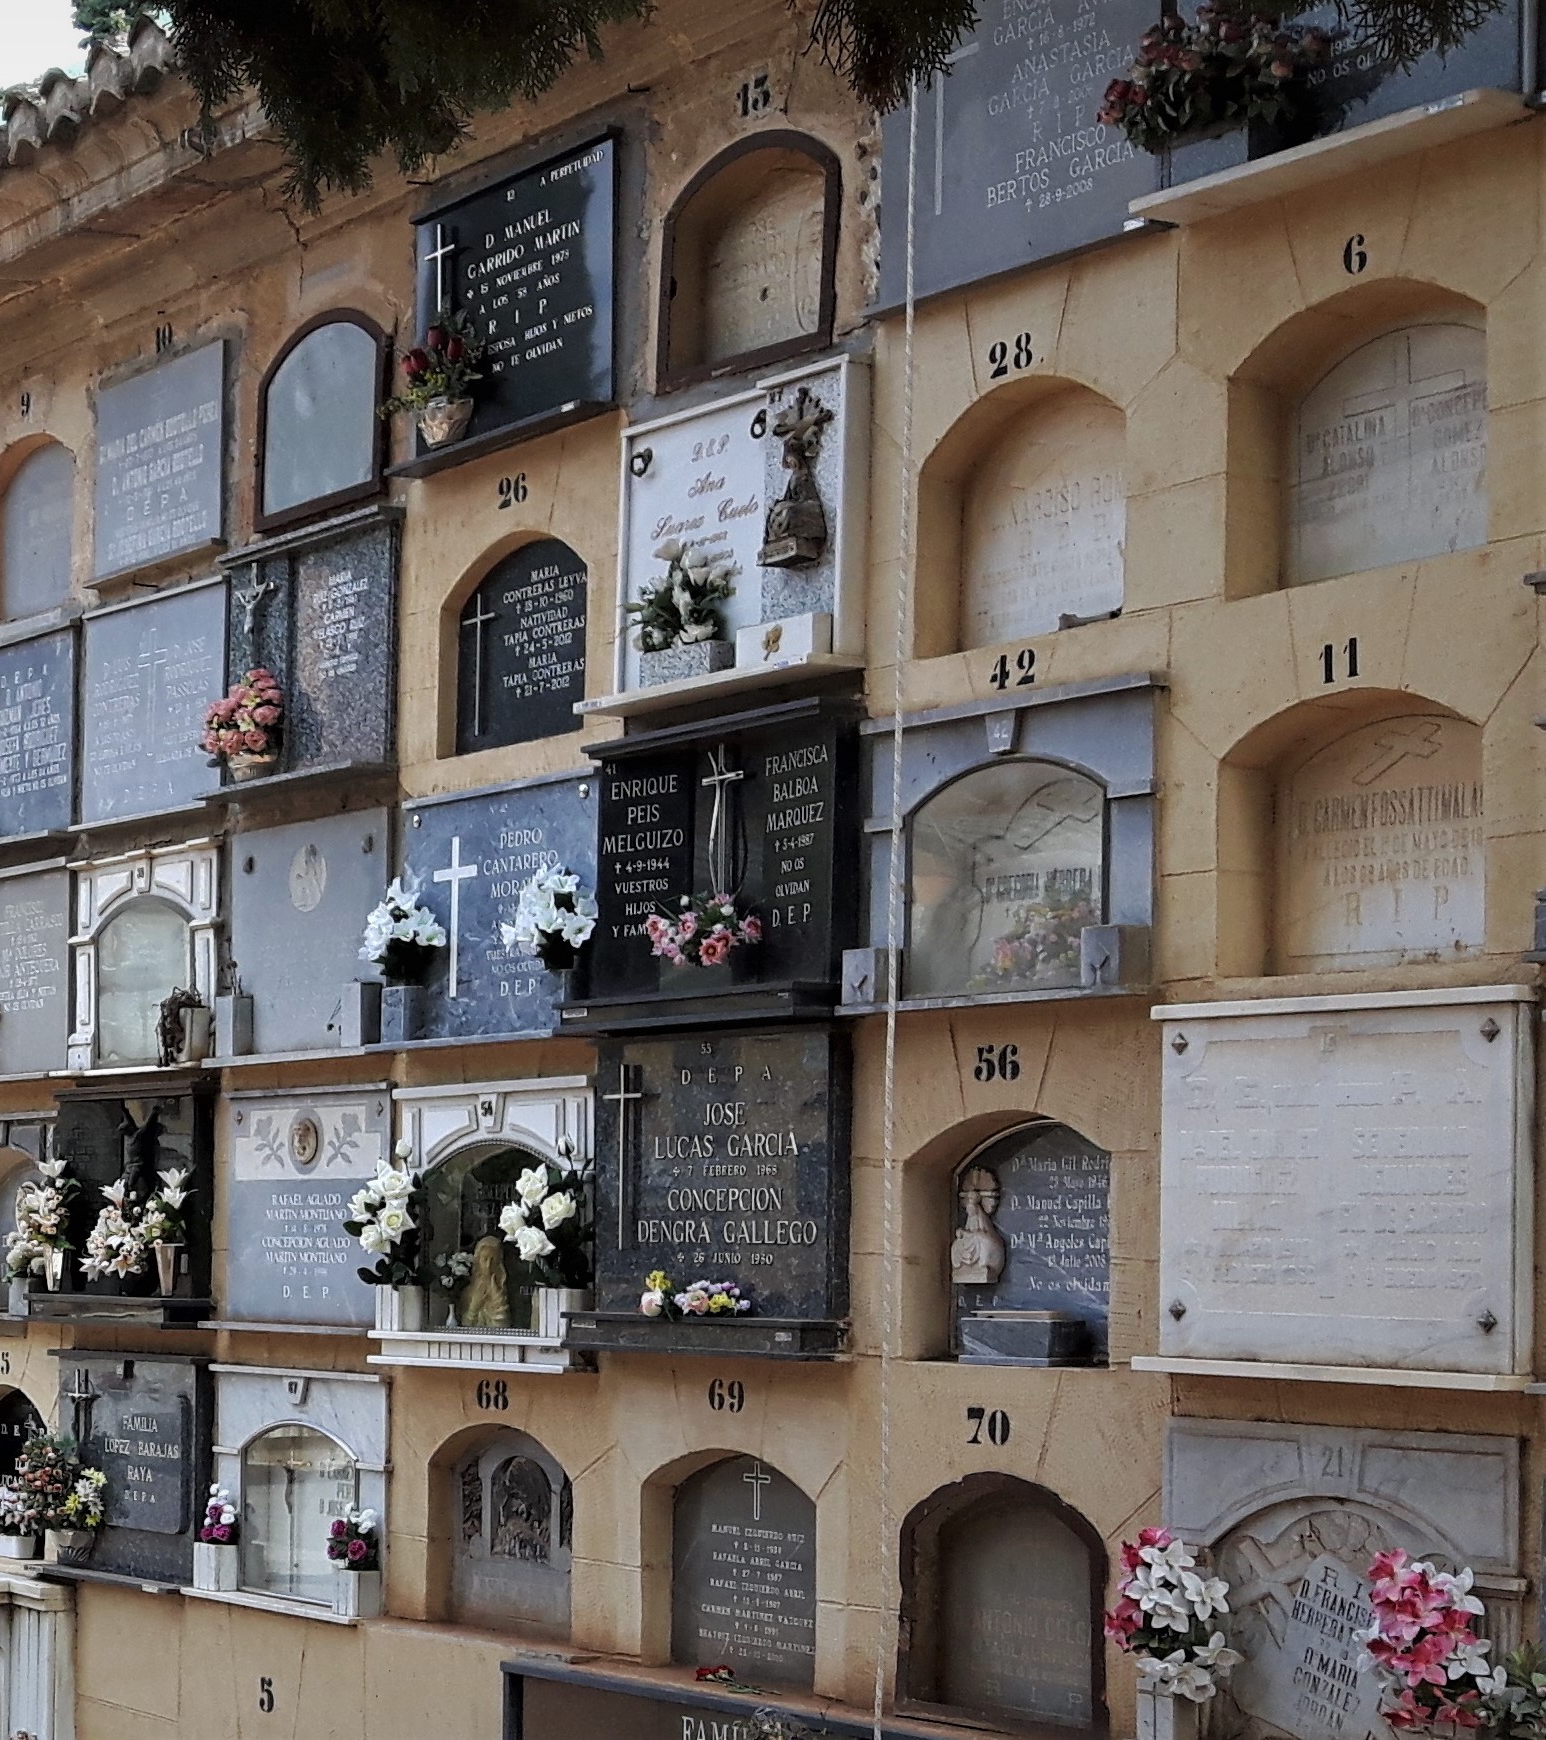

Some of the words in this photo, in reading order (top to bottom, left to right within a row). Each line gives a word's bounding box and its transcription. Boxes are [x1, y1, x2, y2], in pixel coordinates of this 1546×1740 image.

[1012, 30, 1110, 83] ANASTASIA
[1070, 44, 1134, 84] GARCIA
[1015, 124, 1105, 173] FRANCISCO
[1069, 140, 1134, 178] GARCIA
[987, 168, 1049, 207] BERTOS
[504, 209, 552, 241] MANUEL
[467, 244, 524, 279] GARRIDO
[534, 220, 581, 252] MARTIN
[1343, 234, 1366, 274] 6
[536, 273, 560, 291] AÑOS
[988, 332, 1032, 379] 28
[497, 472, 527, 509] 26
[503, 579, 555, 604] CONTRERAS
[558, 571, 588, 589] LEYVA
[530, 565, 560, 583] MARIA
[503, 631, 528, 646] TAPIA
[533, 615, 585, 639] CONTRERAS
[520, 606, 569, 630] NATIVIDAD
[503, 673, 527, 688] TAPIA
[532, 658, 585, 681] CONTRERAS
[529, 652, 557, 669] MARIA
[990, 648, 1036, 692] 42
[1318, 636, 1360, 685] 11
[765, 744, 828, 777] FRANCISCA
[611, 774, 678, 801] ENRIQUE
[773, 775, 819, 802] BALBOA
[627, 804, 660, 825] PEIS
[766, 802, 824, 833] MARQUEZ
[500, 828, 542, 850] PEDRO
[603, 828, 684, 855] MELGUIZO
[483, 850, 559, 877] CANTARERO
[781, 860, 792, 874] NO
[794, 857, 805, 871] OS
[614, 878, 669, 895] VUESTROS
[775, 879, 811, 898] OLVIDAN
[625, 901, 656, 916] HIJOS
[681, 1069, 691, 1085] D
[708, 1067, 717, 1083] E
[735, 1066, 743, 1082] P
[762, 1065, 771, 1081] A
[973, 1043, 1020, 1082] 56
[703, 1102, 746, 1126] JOSE
[655, 1134, 715, 1160] LUCAS
[727, 1132, 799, 1158] GARCIA
[703, 1164, 748, 1178] FEBRERO
[667, 1187, 783, 1212] CONCEPCION
[1027, 1194, 1061, 1211] Manuel
[1066, 1194, 1102, 1213] Capilla
[637, 1219, 711, 1244] DENGRA
[723, 1219, 817, 1245] GALLEGO
[712, 1252, 741, 1265] JUNIO
[476, 1379, 509, 1412] 68
[708, 1378, 745, 1413] 69
[123, 1415, 158, 1433] FAMILIA
[966, 1406, 1010, 1446] 70
[104, 1438, 130, 1455] LOPEZ
[138, 1440, 179, 1459] BARAJAS
[1321, 1446, 1345, 1478] 21
[127, 1465, 153, 1482] RAYA
[259, 1677, 274, 1713] 5
